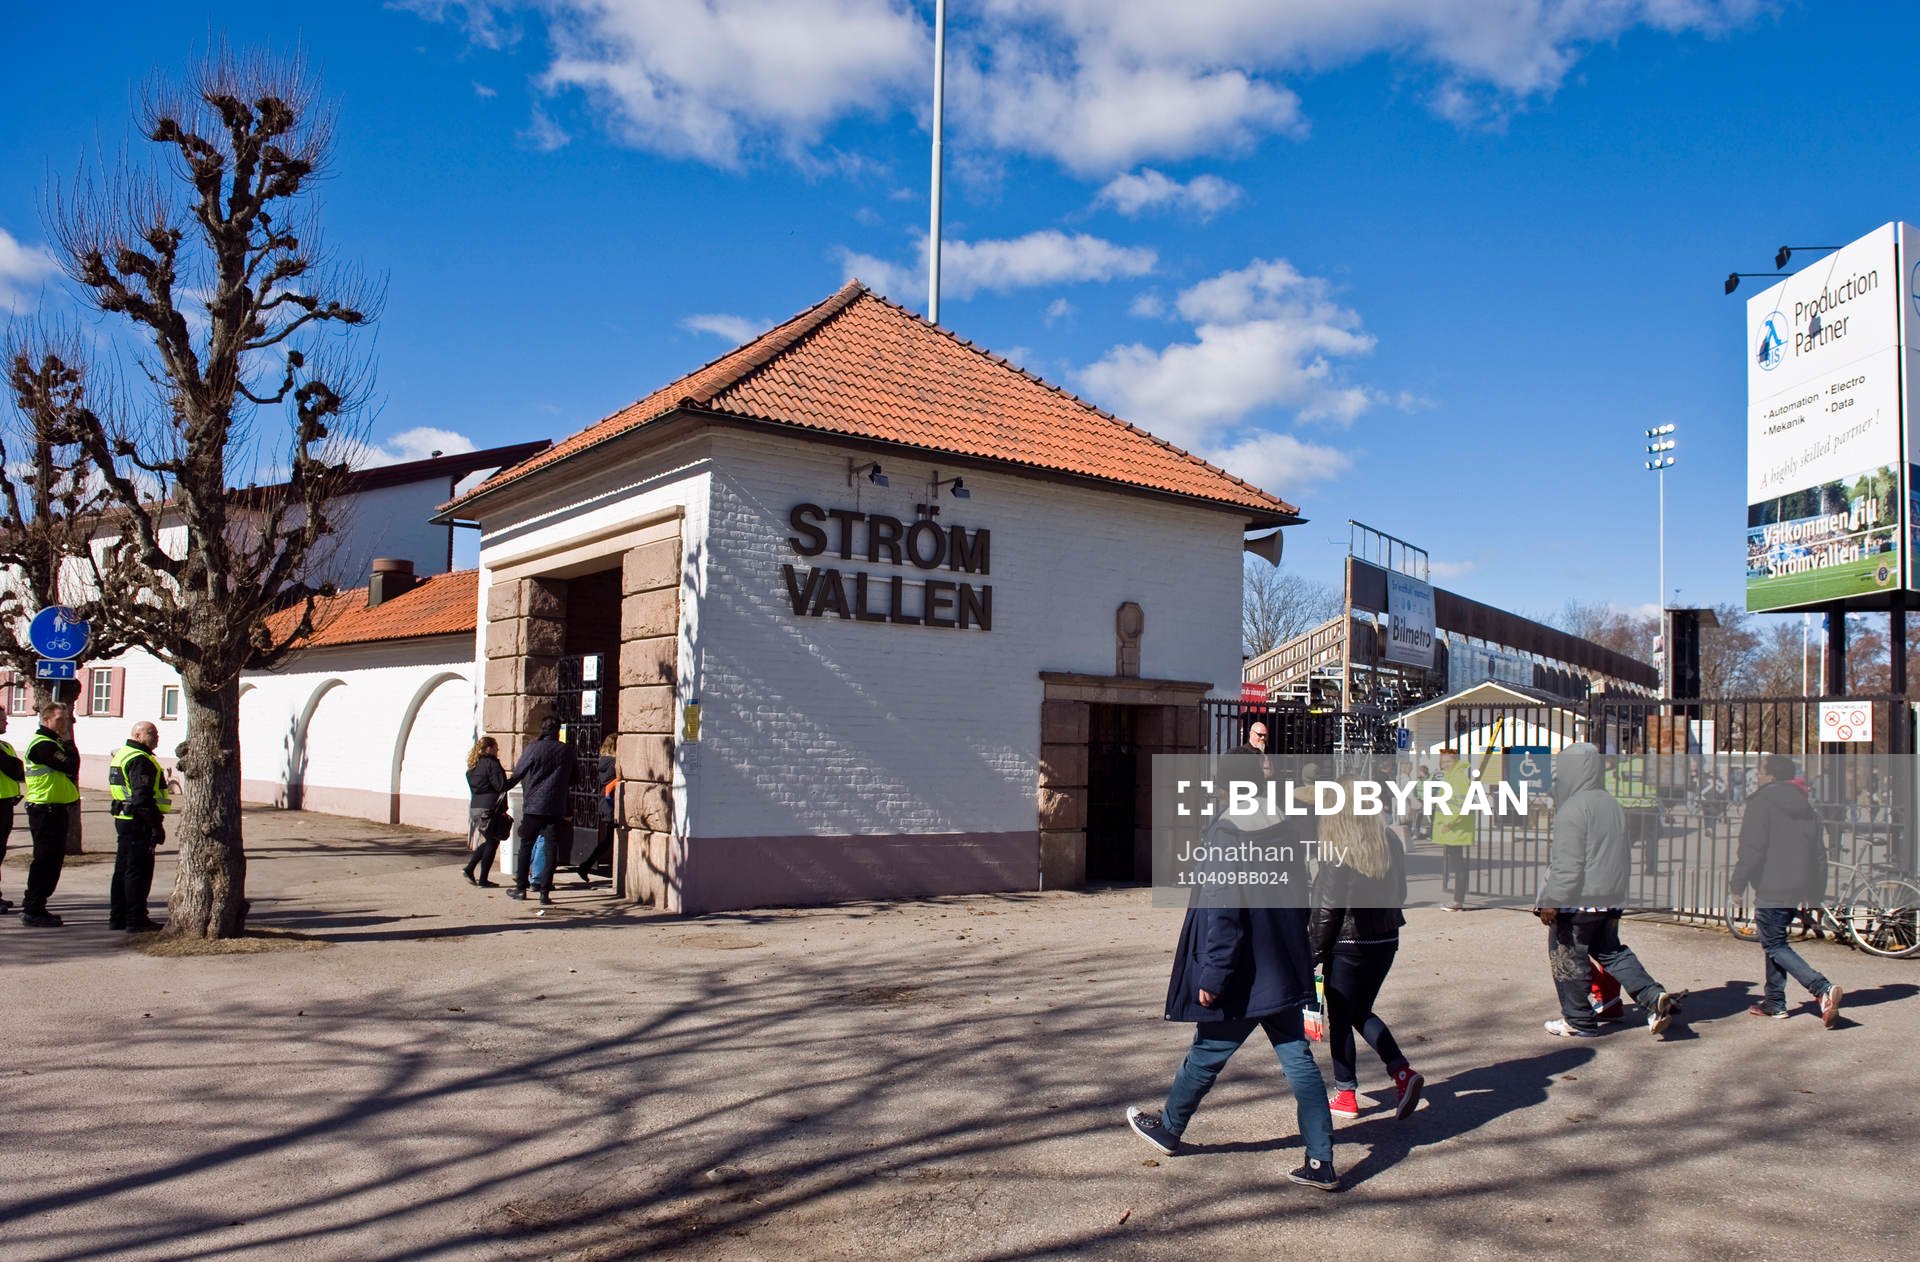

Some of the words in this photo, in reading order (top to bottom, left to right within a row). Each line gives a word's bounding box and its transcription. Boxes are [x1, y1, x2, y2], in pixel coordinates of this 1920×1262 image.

[1795, 269, 1878, 326] Production
[1795, 316, 1849, 357] Partner
[1831, 375, 1866, 395] Electro
[1768, 392, 1820, 419] Automation
[1831, 398, 1854, 413] Data
[1768, 415, 1806, 437] Mekanik
[1771, 456, 1798, 484] highly
[1800, 435, 1831, 467] skilled
[1833, 417, 1873, 455] partner
[789, 503, 991, 576] STRÖM
[1763, 511, 1849, 549] Välkommen
[782, 563, 993, 632] VALLEN
[1392, 615, 1432, 649] Bilmetro
